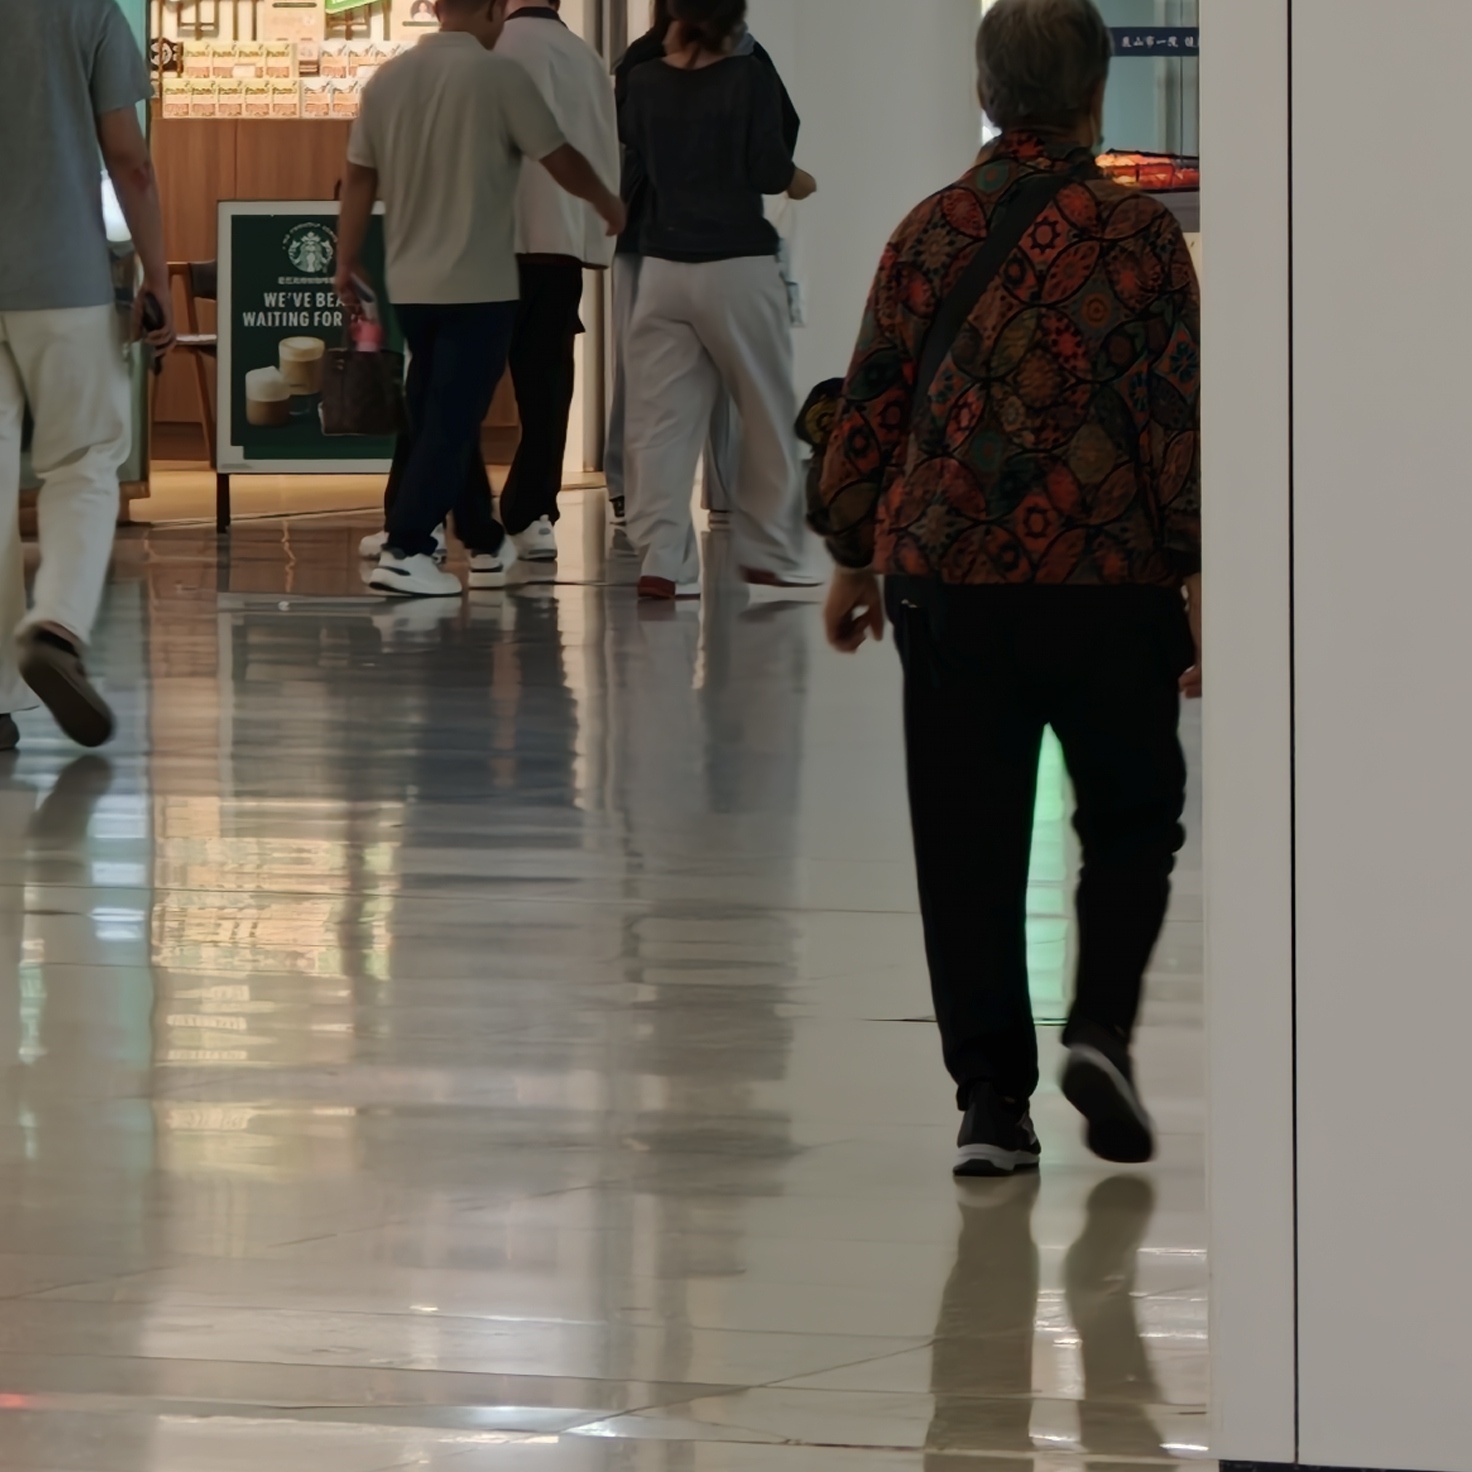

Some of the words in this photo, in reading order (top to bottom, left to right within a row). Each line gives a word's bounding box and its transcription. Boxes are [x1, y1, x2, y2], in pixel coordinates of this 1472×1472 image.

[263, 291, 312, 308] WE'VE
[316, 291, 345, 308] BEA
[242, 311, 310, 327] WAITING
[313, 311, 343, 327] FOR
